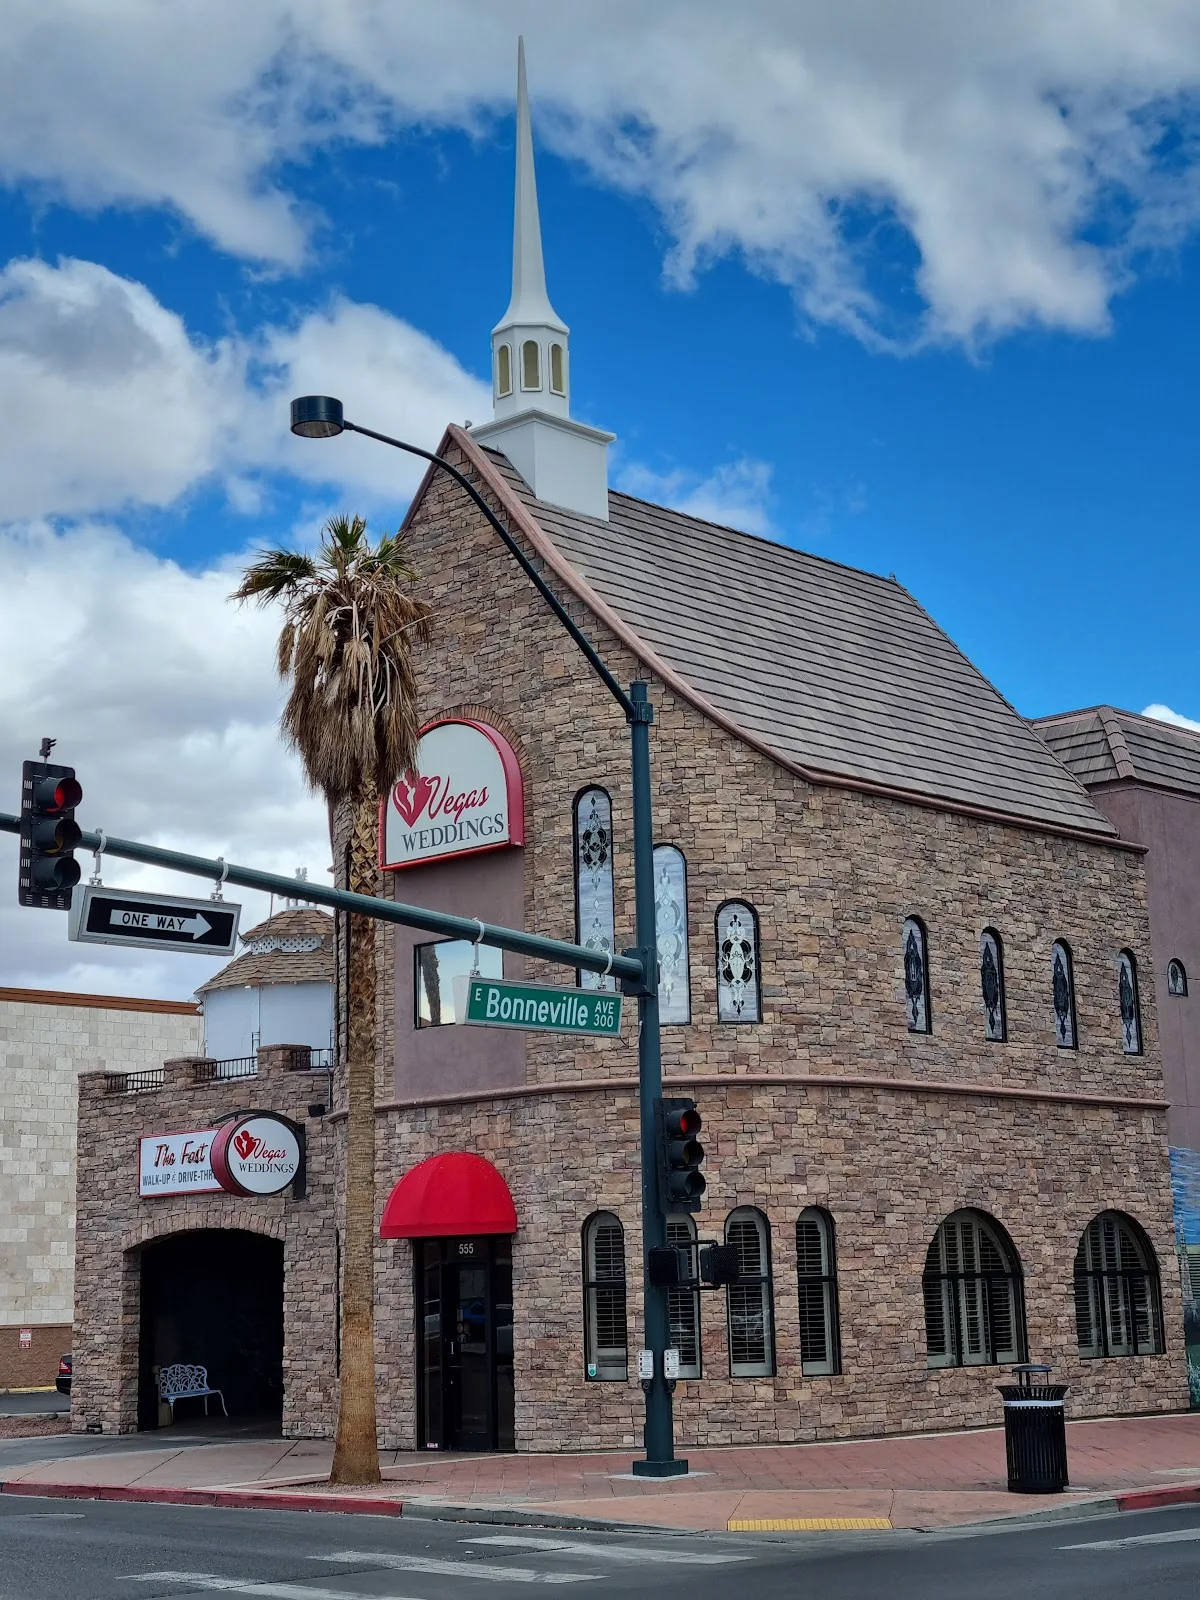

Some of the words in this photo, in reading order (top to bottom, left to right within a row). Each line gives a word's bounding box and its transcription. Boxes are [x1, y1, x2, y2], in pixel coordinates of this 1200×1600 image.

[428, 775, 490, 825] Vegas
[402, 813, 504, 852] WEDDINGS
[122, 912, 149, 926] ONE
[157, 916, 186, 930] WAY
[475, 988, 482, 1001] E
[486, 988, 589, 1027] Bonneville
[594, 1001, 615, 1015] AVE
[593, 1013, 614, 1028] 300
[154, 1143, 176, 1168] The
[252, 1138, 287, 1163] Vegas
[239, 1162, 295, 1174] WEDDINGS
[142, 1173, 171, 1187] WALK-UP
[459, 1243, 474, 1254] 555
